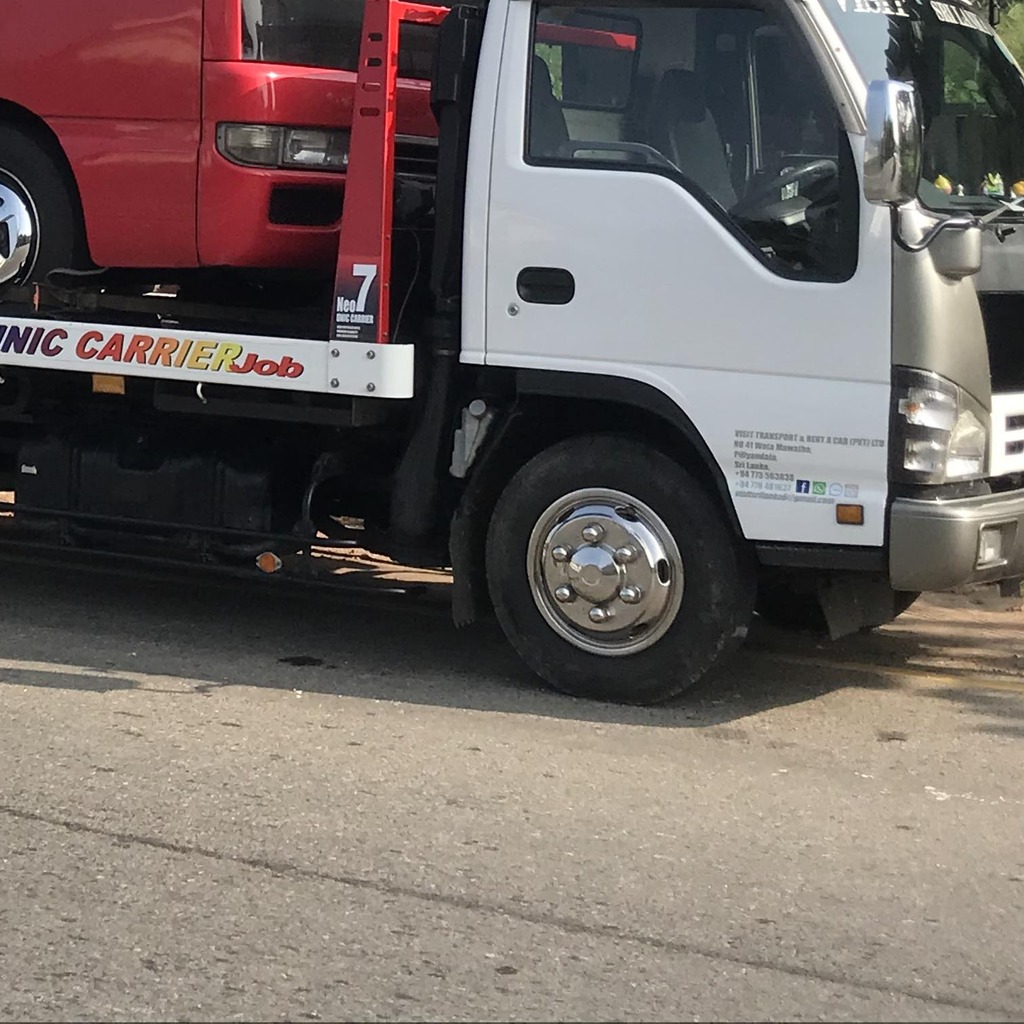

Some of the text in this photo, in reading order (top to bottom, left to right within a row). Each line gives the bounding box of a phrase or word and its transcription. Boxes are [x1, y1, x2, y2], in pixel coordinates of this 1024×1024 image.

[336, 263, 377, 313] Neo 7
[75, 330, 243, 373] CARRIER
[229, 352, 305, 378] Job
[755, 431, 798, 442] TRANSPORT
[832, 437, 848, 446] CAR
